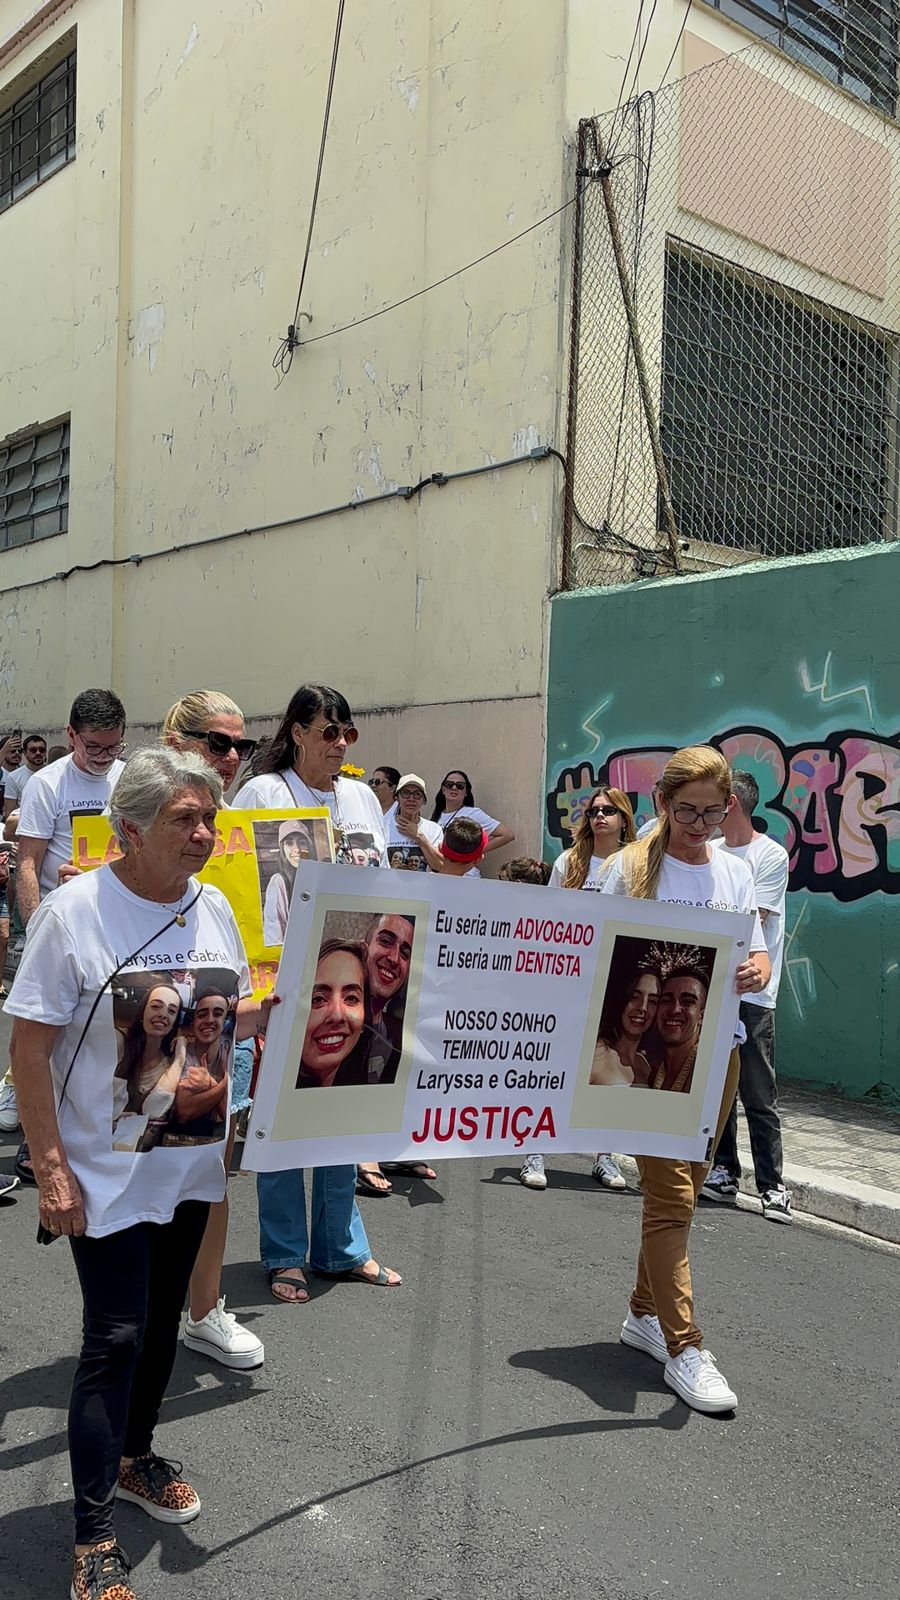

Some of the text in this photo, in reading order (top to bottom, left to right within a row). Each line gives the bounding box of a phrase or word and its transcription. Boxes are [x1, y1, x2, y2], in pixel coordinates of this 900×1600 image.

[72, 800, 103, 808] Laryssa
[435, 909, 595, 947] Eu seria um ADVOGADO
[115, 955, 172, 968] Laryssa
[175, 952, 185, 963] e
[437, 944, 581, 977] Eu seria um DENTISTA
[444, 1009, 557, 1034] NOSSO SONHO
[442, 1039, 551, 1062] TEMINOU AQUI
[416, 1069, 566, 1095] Laryssa e Gabriel
[411, 1105, 557, 1148] JUSTIÇA
